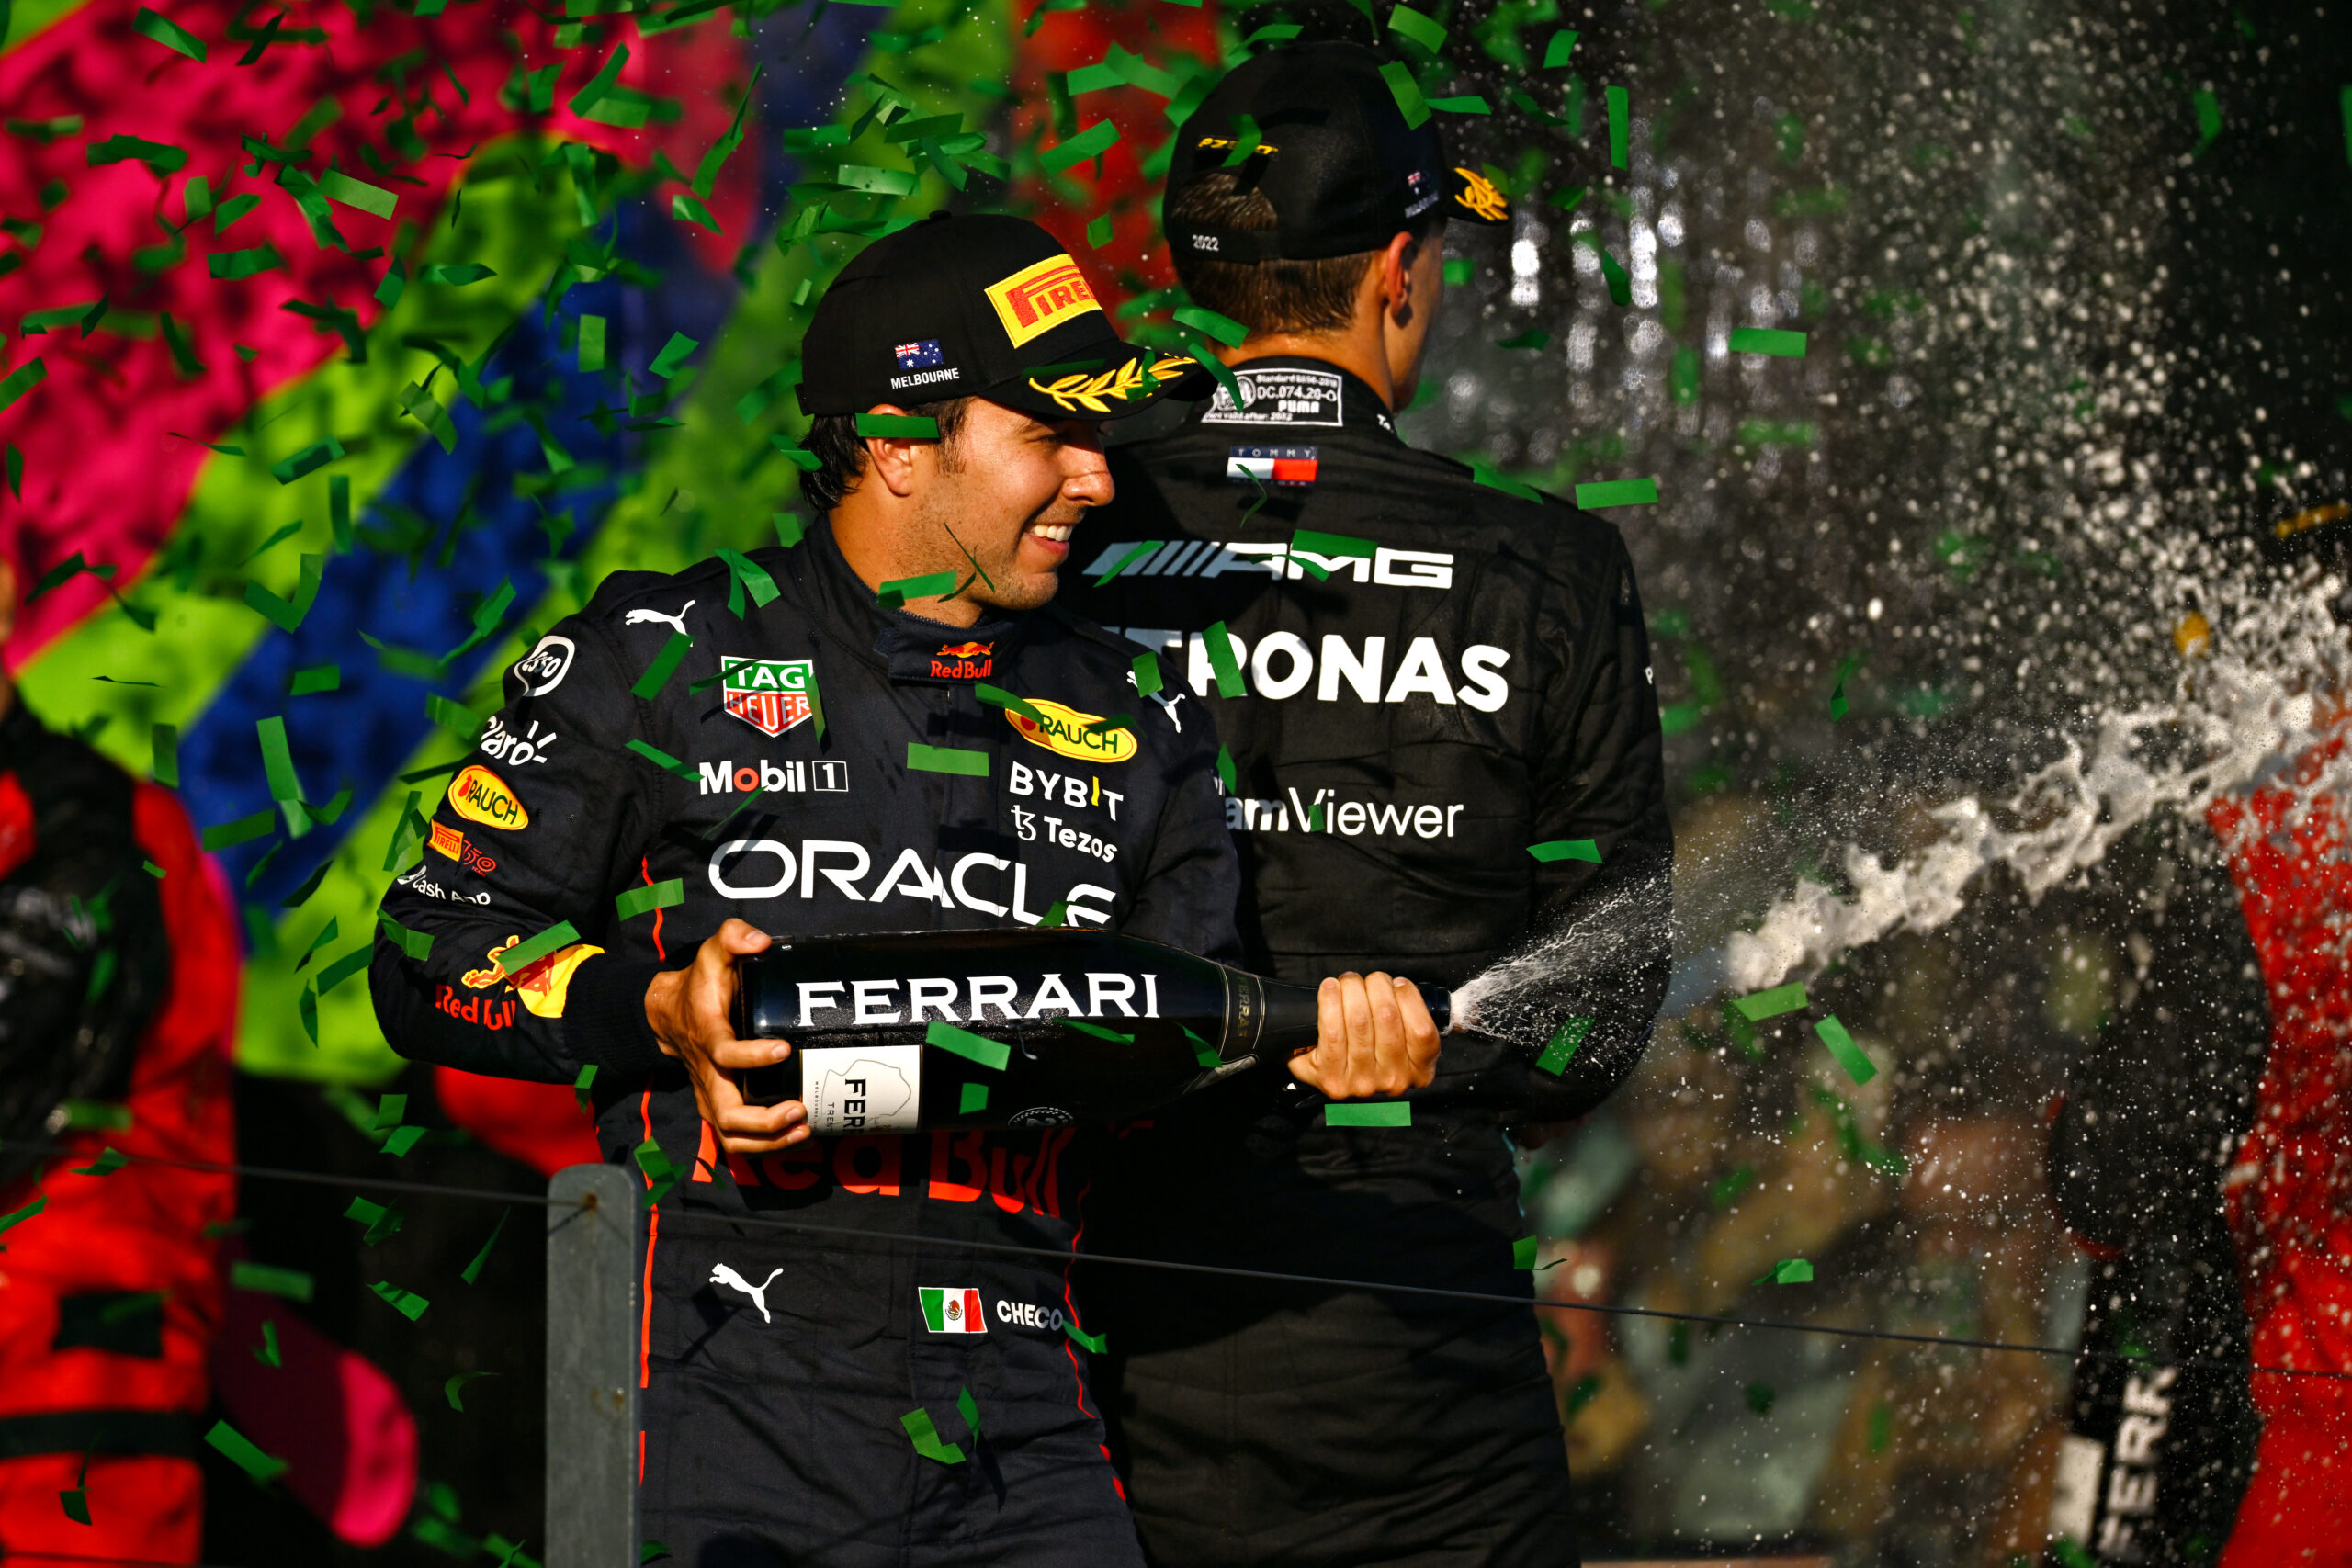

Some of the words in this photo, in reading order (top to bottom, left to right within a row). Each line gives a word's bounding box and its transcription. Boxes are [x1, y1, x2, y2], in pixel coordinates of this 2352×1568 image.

[1193, 234, 1219, 251] 2022
[890, 367, 960, 389] MELBOURNE
[1278, 400, 1320, 413] PUMA
[1238, 448, 1312, 457] TOMMY
[1200, 542, 1453, 589] AMG
[729, 662, 805, 689] TAG
[930, 660, 963, 679] Red
[964, 659, 992, 679] Bull
[1102, 625, 1510, 713] TRONAS
[729, 694, 810, 731] HEUER
[1039, 714, 1118, 754] RAUCH
[699, 759, 806, 795] Mobil
[822, 762, 835, 789] 1
[1009, 761, 1124, 821] BYBIT
[465, 779, 519, 825] RAUCH
[1225, 787, 1463, 837] amViewer
[434, 826, 460, 855] PIRELLI
[1043, 815, 1118, 863] Tezos
[708, 840, 1117, 928] ORACLE
[435, 983, 479, 1025] Red
[796, 972, 1159, 1028] FERRARI
[928, 1128, 1076, 1220] Bull
[996, 1300, 1064, 1331] CHECO
